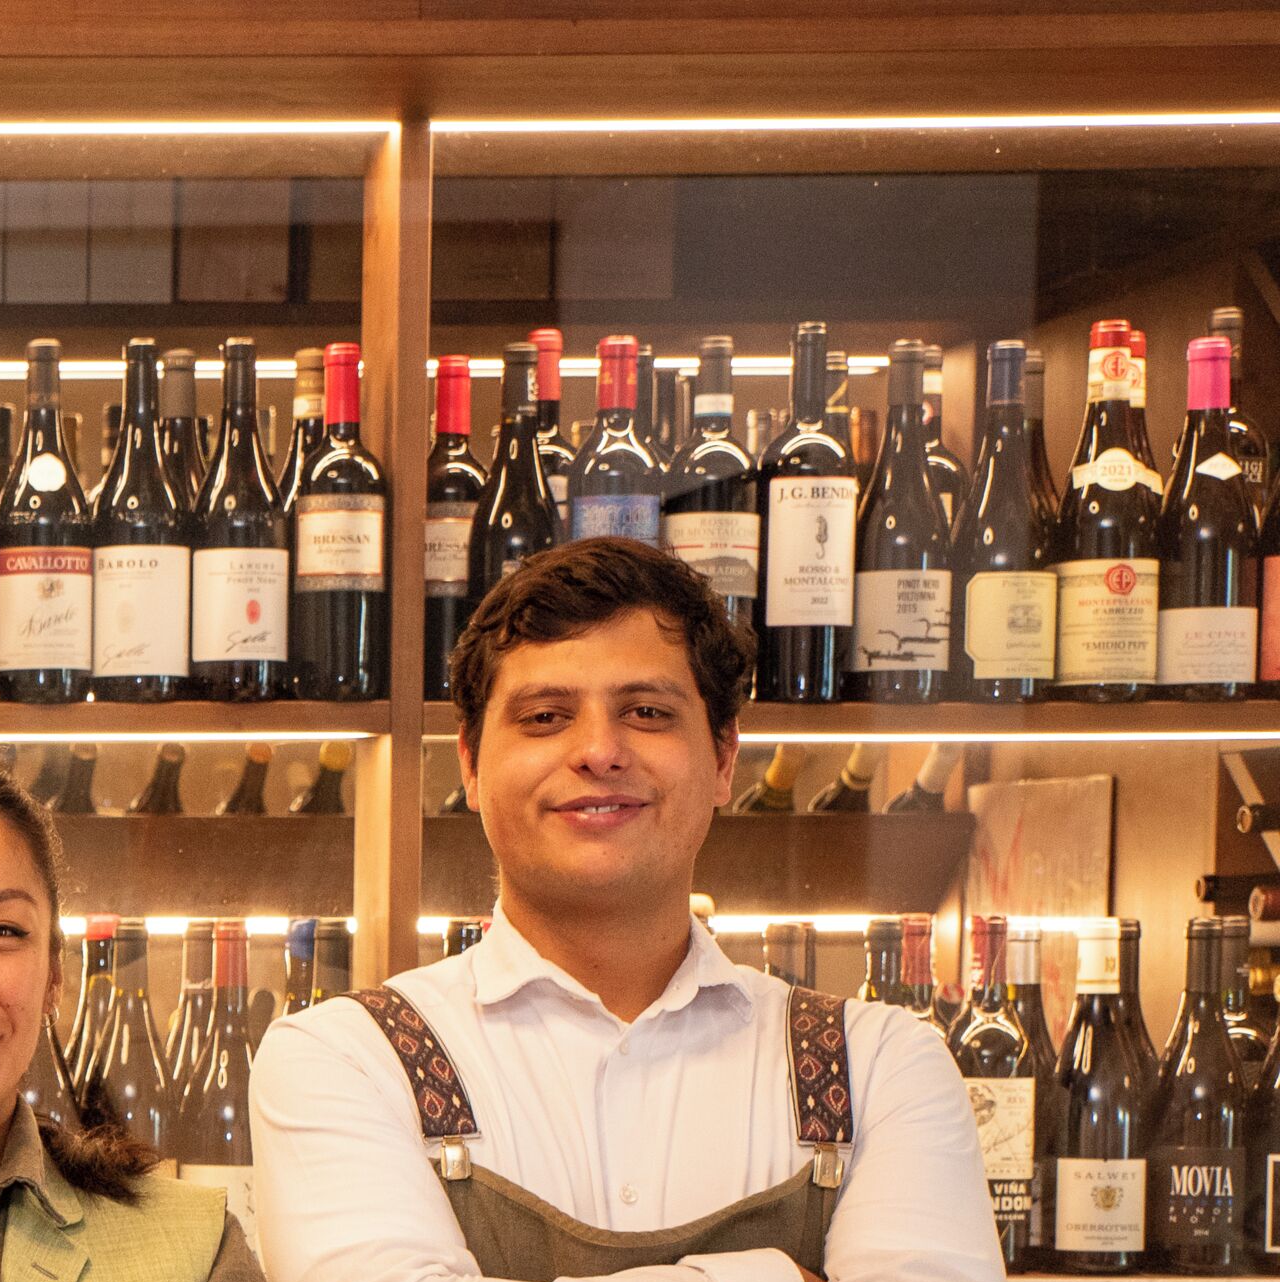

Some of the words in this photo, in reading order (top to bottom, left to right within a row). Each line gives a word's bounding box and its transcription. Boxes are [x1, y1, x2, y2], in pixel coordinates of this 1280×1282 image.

[1100, 465, 1132, 477] 2021
[313, 534, 371, 545] BRESSAN
[6, 555, 89, 571] CAVALLOTTO
[98, 558, 159, 571] BAROLO
[1169, 1165, 1234, 1197] MOVIA
